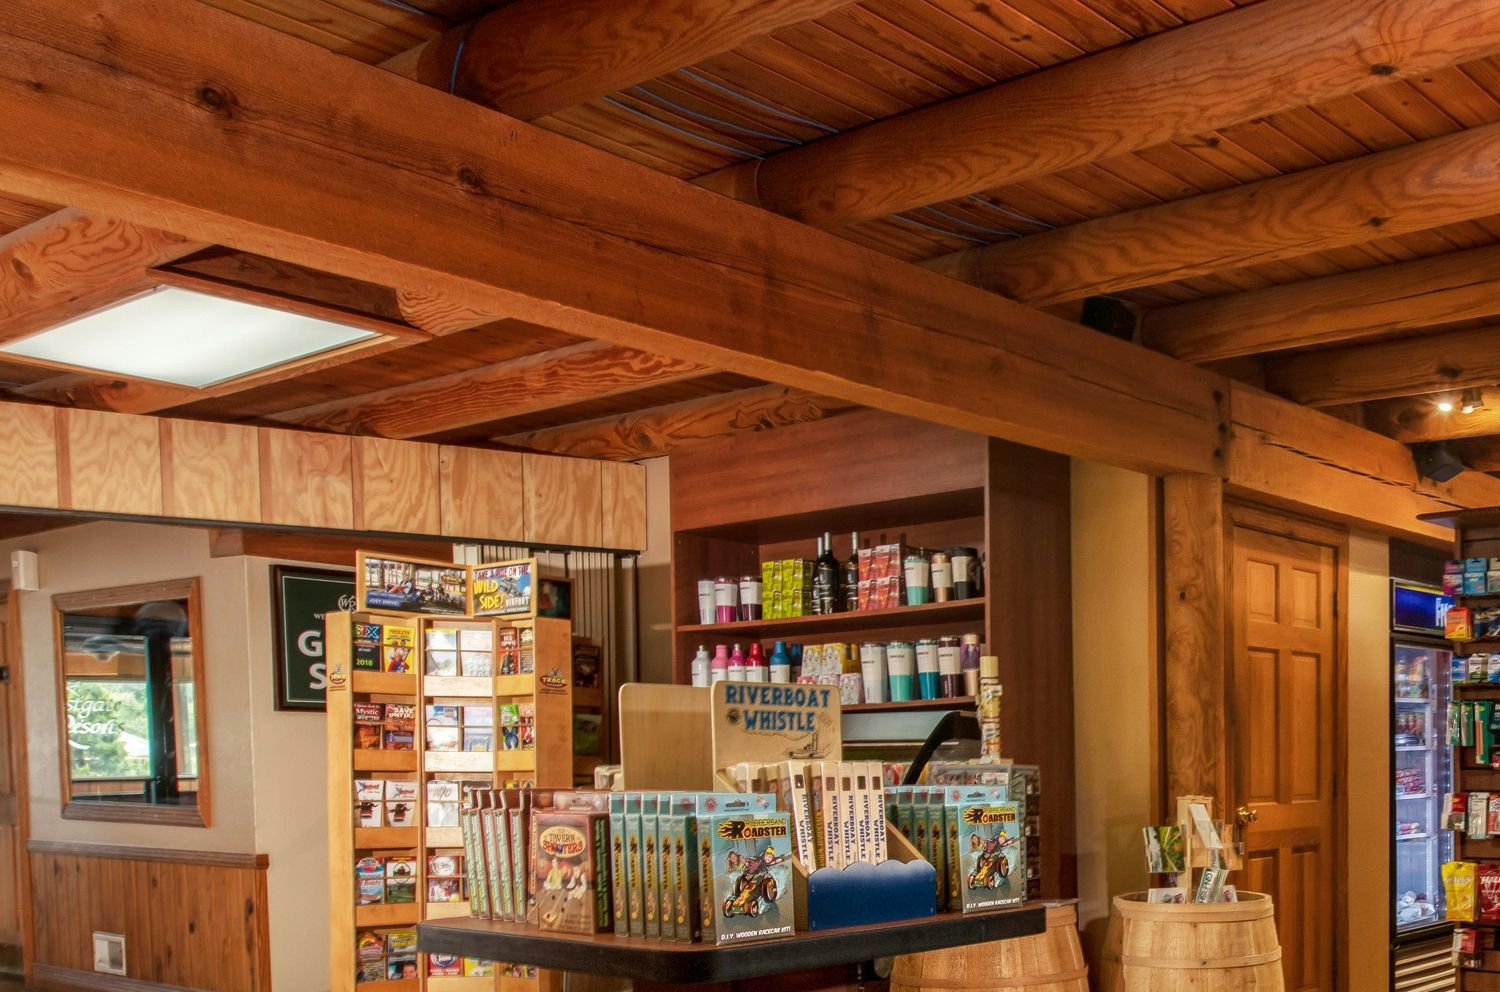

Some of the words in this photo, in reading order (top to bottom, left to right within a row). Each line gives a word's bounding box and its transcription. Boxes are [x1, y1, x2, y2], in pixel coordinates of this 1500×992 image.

[474, 580, 498, 594] WILD
[480, 593, 504, 609] SIDE!
[725, 685, 830, 708] RIVERBOAT
[743, 710, 816, 731] WHISTLE
[746, 818, 786, 827] RUBBERBAND
[802, 794, 812, 842] RIVERBOAT
[972, 809, 1015, 823] ROADSTER
[730, 820, 787, 838] ROADSTER
[549, 833, 575, 842] TAVERN
[800, 820, 808, 860] WHISTLE
[736, 930, 757, 938] WOODEN
